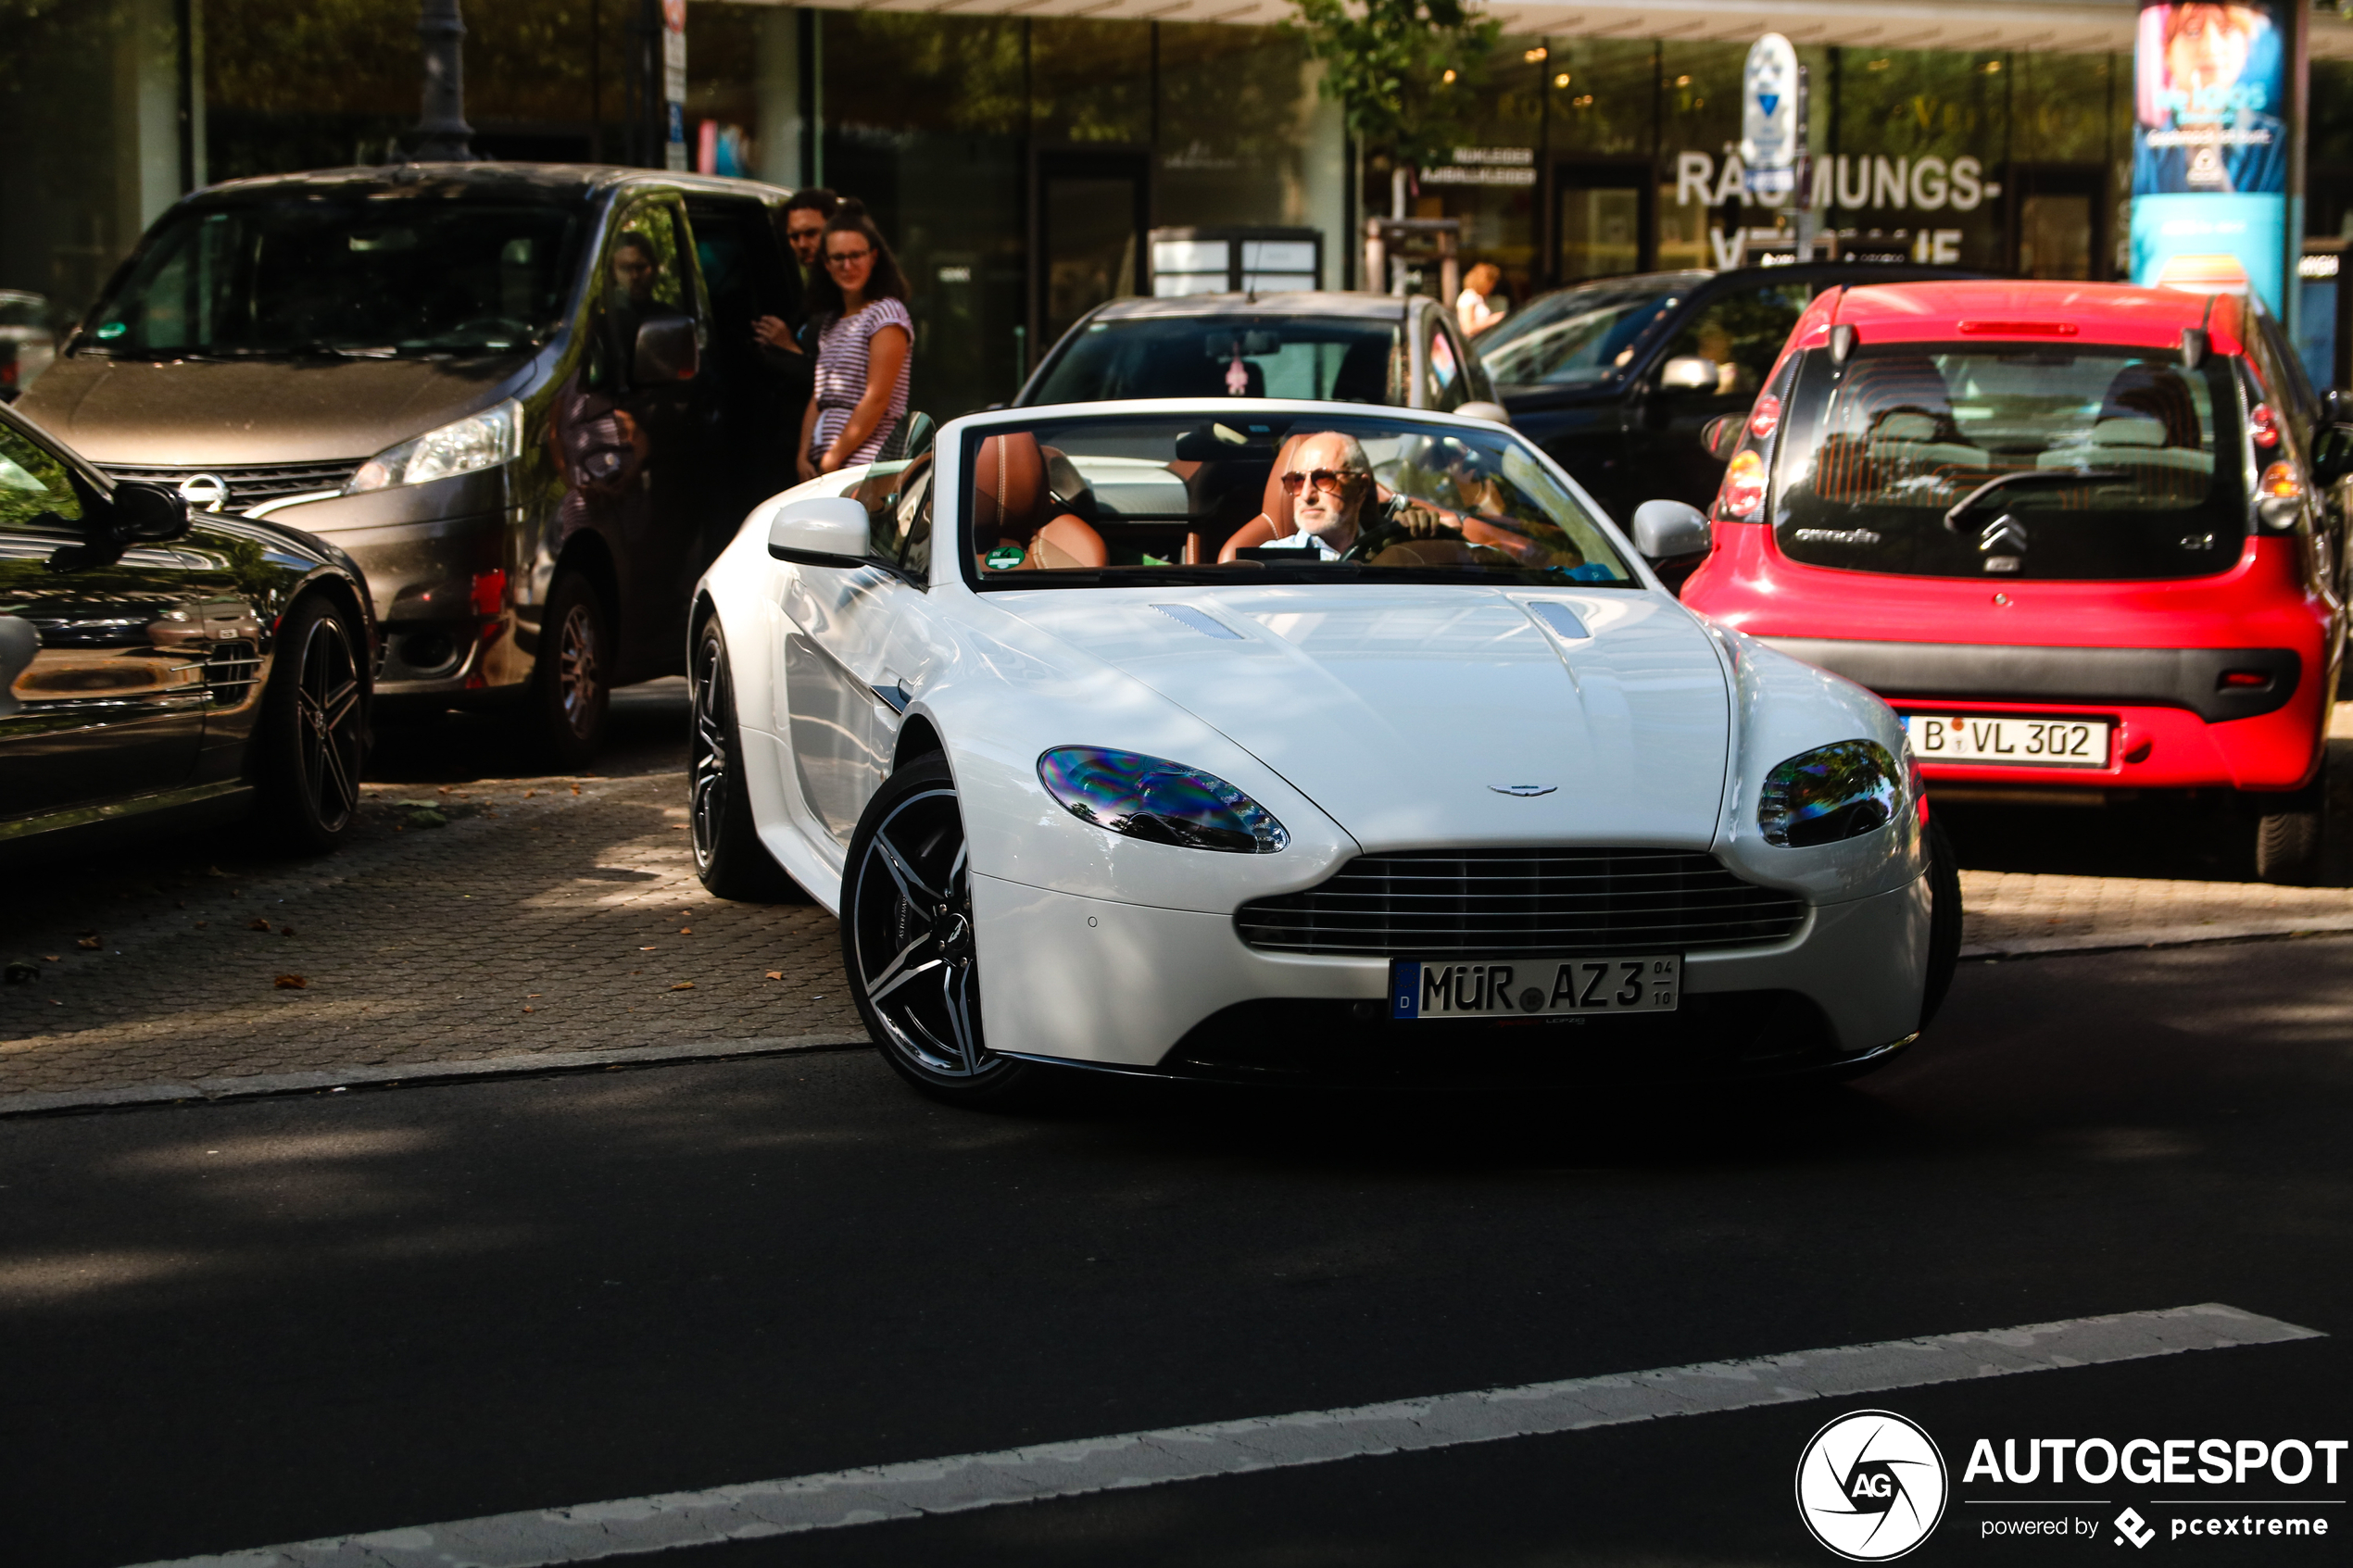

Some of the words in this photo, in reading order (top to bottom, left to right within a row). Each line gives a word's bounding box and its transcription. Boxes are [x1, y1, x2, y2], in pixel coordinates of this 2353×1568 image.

[1000, 547, 1012, 558] 4
[1925, 720, 1944, 750] B
[1973, 720, 2015, 753] VL
[2026, 722, 2089, 756] 302
[1654, 960, 1671, 975] 04
[1420, 964, 1514, 1011] MÜR
[1548, 962, 1608, 1009] AZ
[1616, 961, 1644, 1007] 3
[1400, 996, 1410, 1010] D
[1654, 990, 1670, 1006] 10
